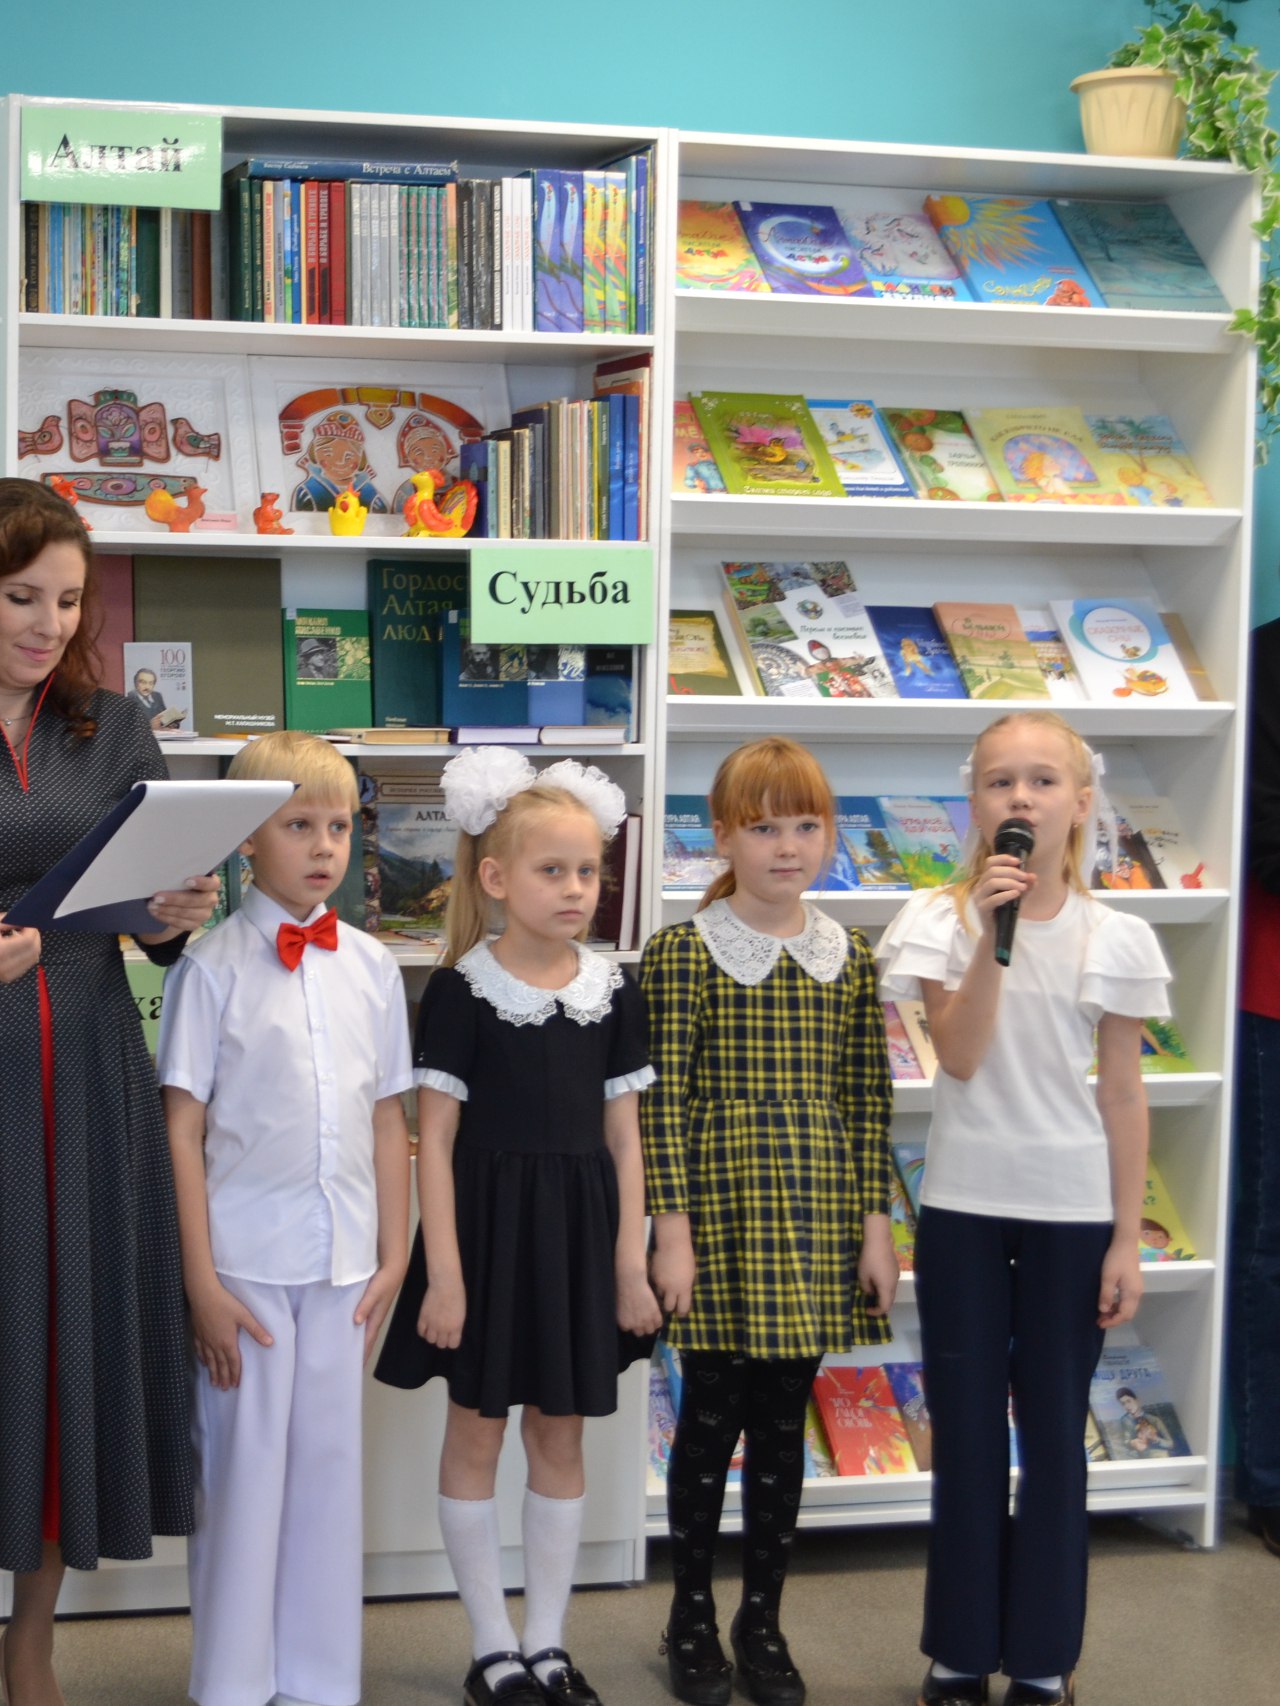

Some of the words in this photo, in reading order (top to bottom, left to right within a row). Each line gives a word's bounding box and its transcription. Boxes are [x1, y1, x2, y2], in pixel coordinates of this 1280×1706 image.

[49, 132, 183, 173] Алтай
[362, 163, 402, 177] Встреча
[404, 166, 411, 175] с
[413, 164, 451, 176] Алтаем
[381, 567, 465, 598] Гордос
[487, 570, 631, 615] Судьба
[381, 593, 453, 616] Алтая
[159, 648, 186, 665] 100
[415, 811, 452, 821] АЛТА
